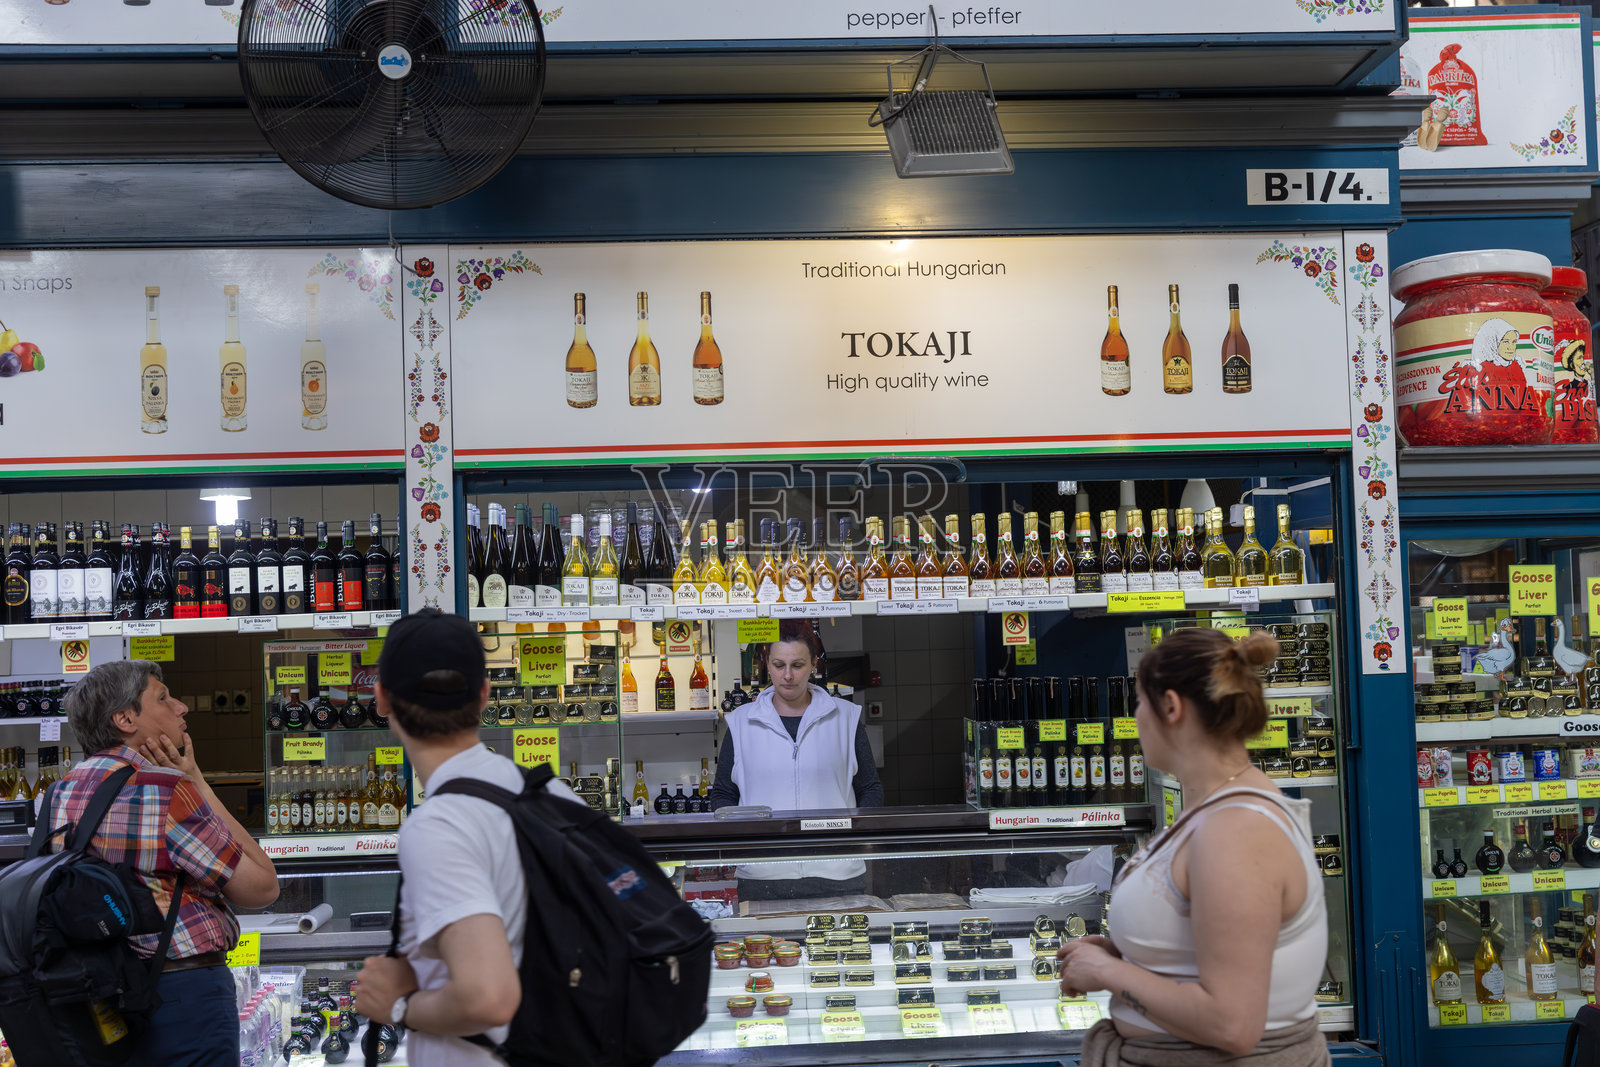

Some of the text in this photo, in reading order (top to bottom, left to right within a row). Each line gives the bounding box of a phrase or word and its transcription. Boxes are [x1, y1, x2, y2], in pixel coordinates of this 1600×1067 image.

[847, 7, 1022, 30] pepper pfeffer
[1429, 72, 1475, 86] PAPRIKA
[802, 260, 1006, 280] Traditional Hungarian
[12, 274, 73, 294] Snaps
[841, 331, 972, 364] TOKAJI
[1167, 367, 1189, 376] TOKAJI
[1225, 367, 1249, 376] TOKAJI
[827, 371, 989, 393] High quality wine
[1444, 385, 1540, 414] ANNA
[1562, 399, 1599, 422] PIS
[1512, 571, 1553, 583] Goose
[1518, 589, 1548, 600] Liver
[1437, 603, 1464, 611] Goose
[344, 642, 365, 650] Liquer
[522, 643, 563, 655] Goose
[528, 661, 558, 671] Liver
[321, 669, 350, 677] Unicum
[1564, 721, 1600, 733] Goos
[515, 734, 557, 746] Goose
[522, 752, 552, 763] Liver
[995, 816, 1040, 826] Hungarian
[1081, 812, 1120, 822] Pálinka
[263, 845, 309, 856] Hungarian
[356, 839, 397, 850] Pálinka
[1534, 876, 1564, 884] Unicum
[823, 1015, 860, 1024] Goose
[903, 1012, 940, 1020] Goose
[1442, 1010, 1464, 1018] Tokaji
